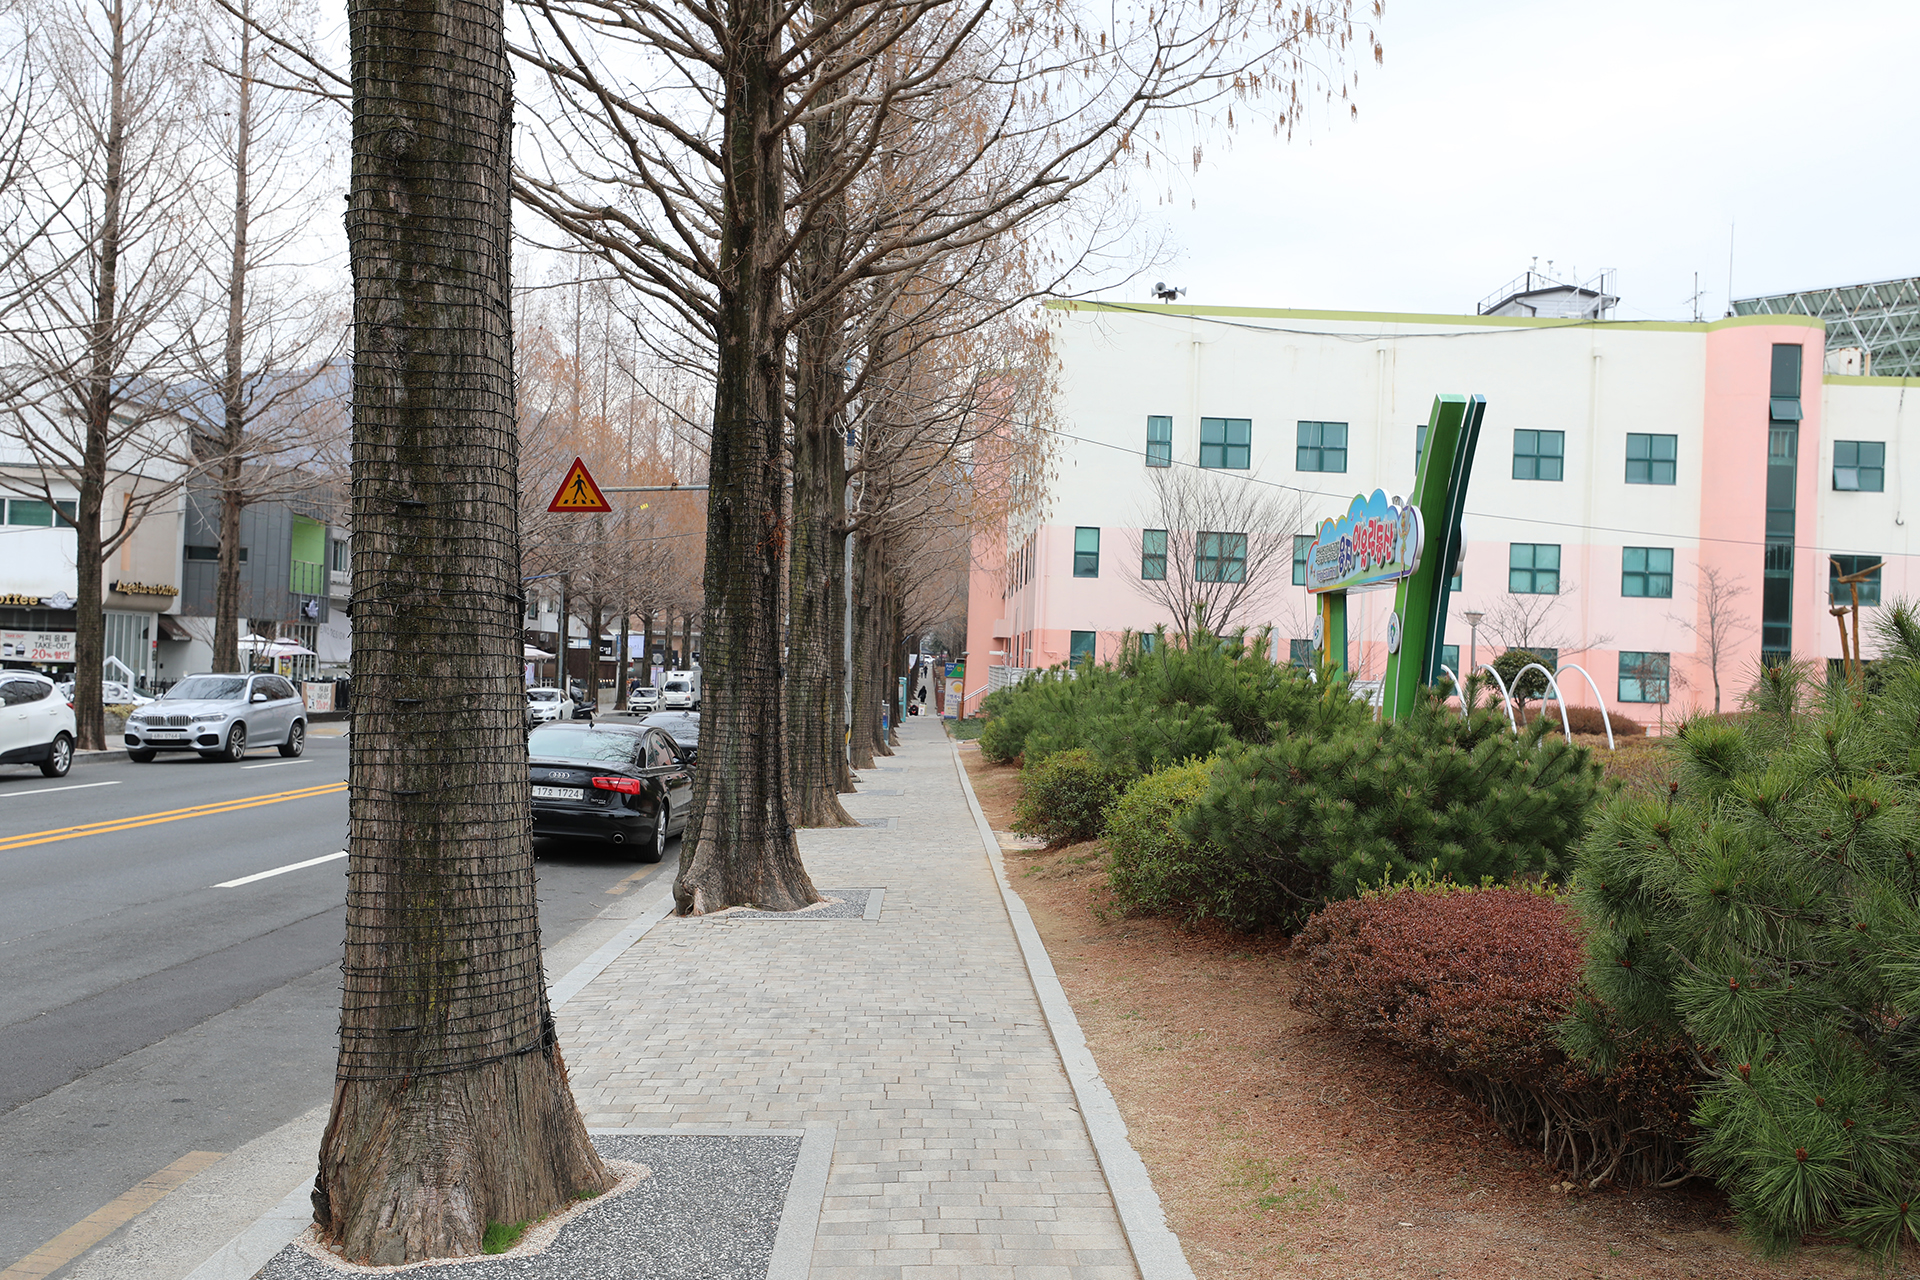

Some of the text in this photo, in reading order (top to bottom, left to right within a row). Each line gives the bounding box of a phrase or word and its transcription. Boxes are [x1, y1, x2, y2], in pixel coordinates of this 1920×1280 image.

[38, 634, 52, 642] 커피
[34, 642, 71, 650] TAKE-OUT
[31, 648, 53, 660] 20%
[557, 788, 579, 798] 1724
